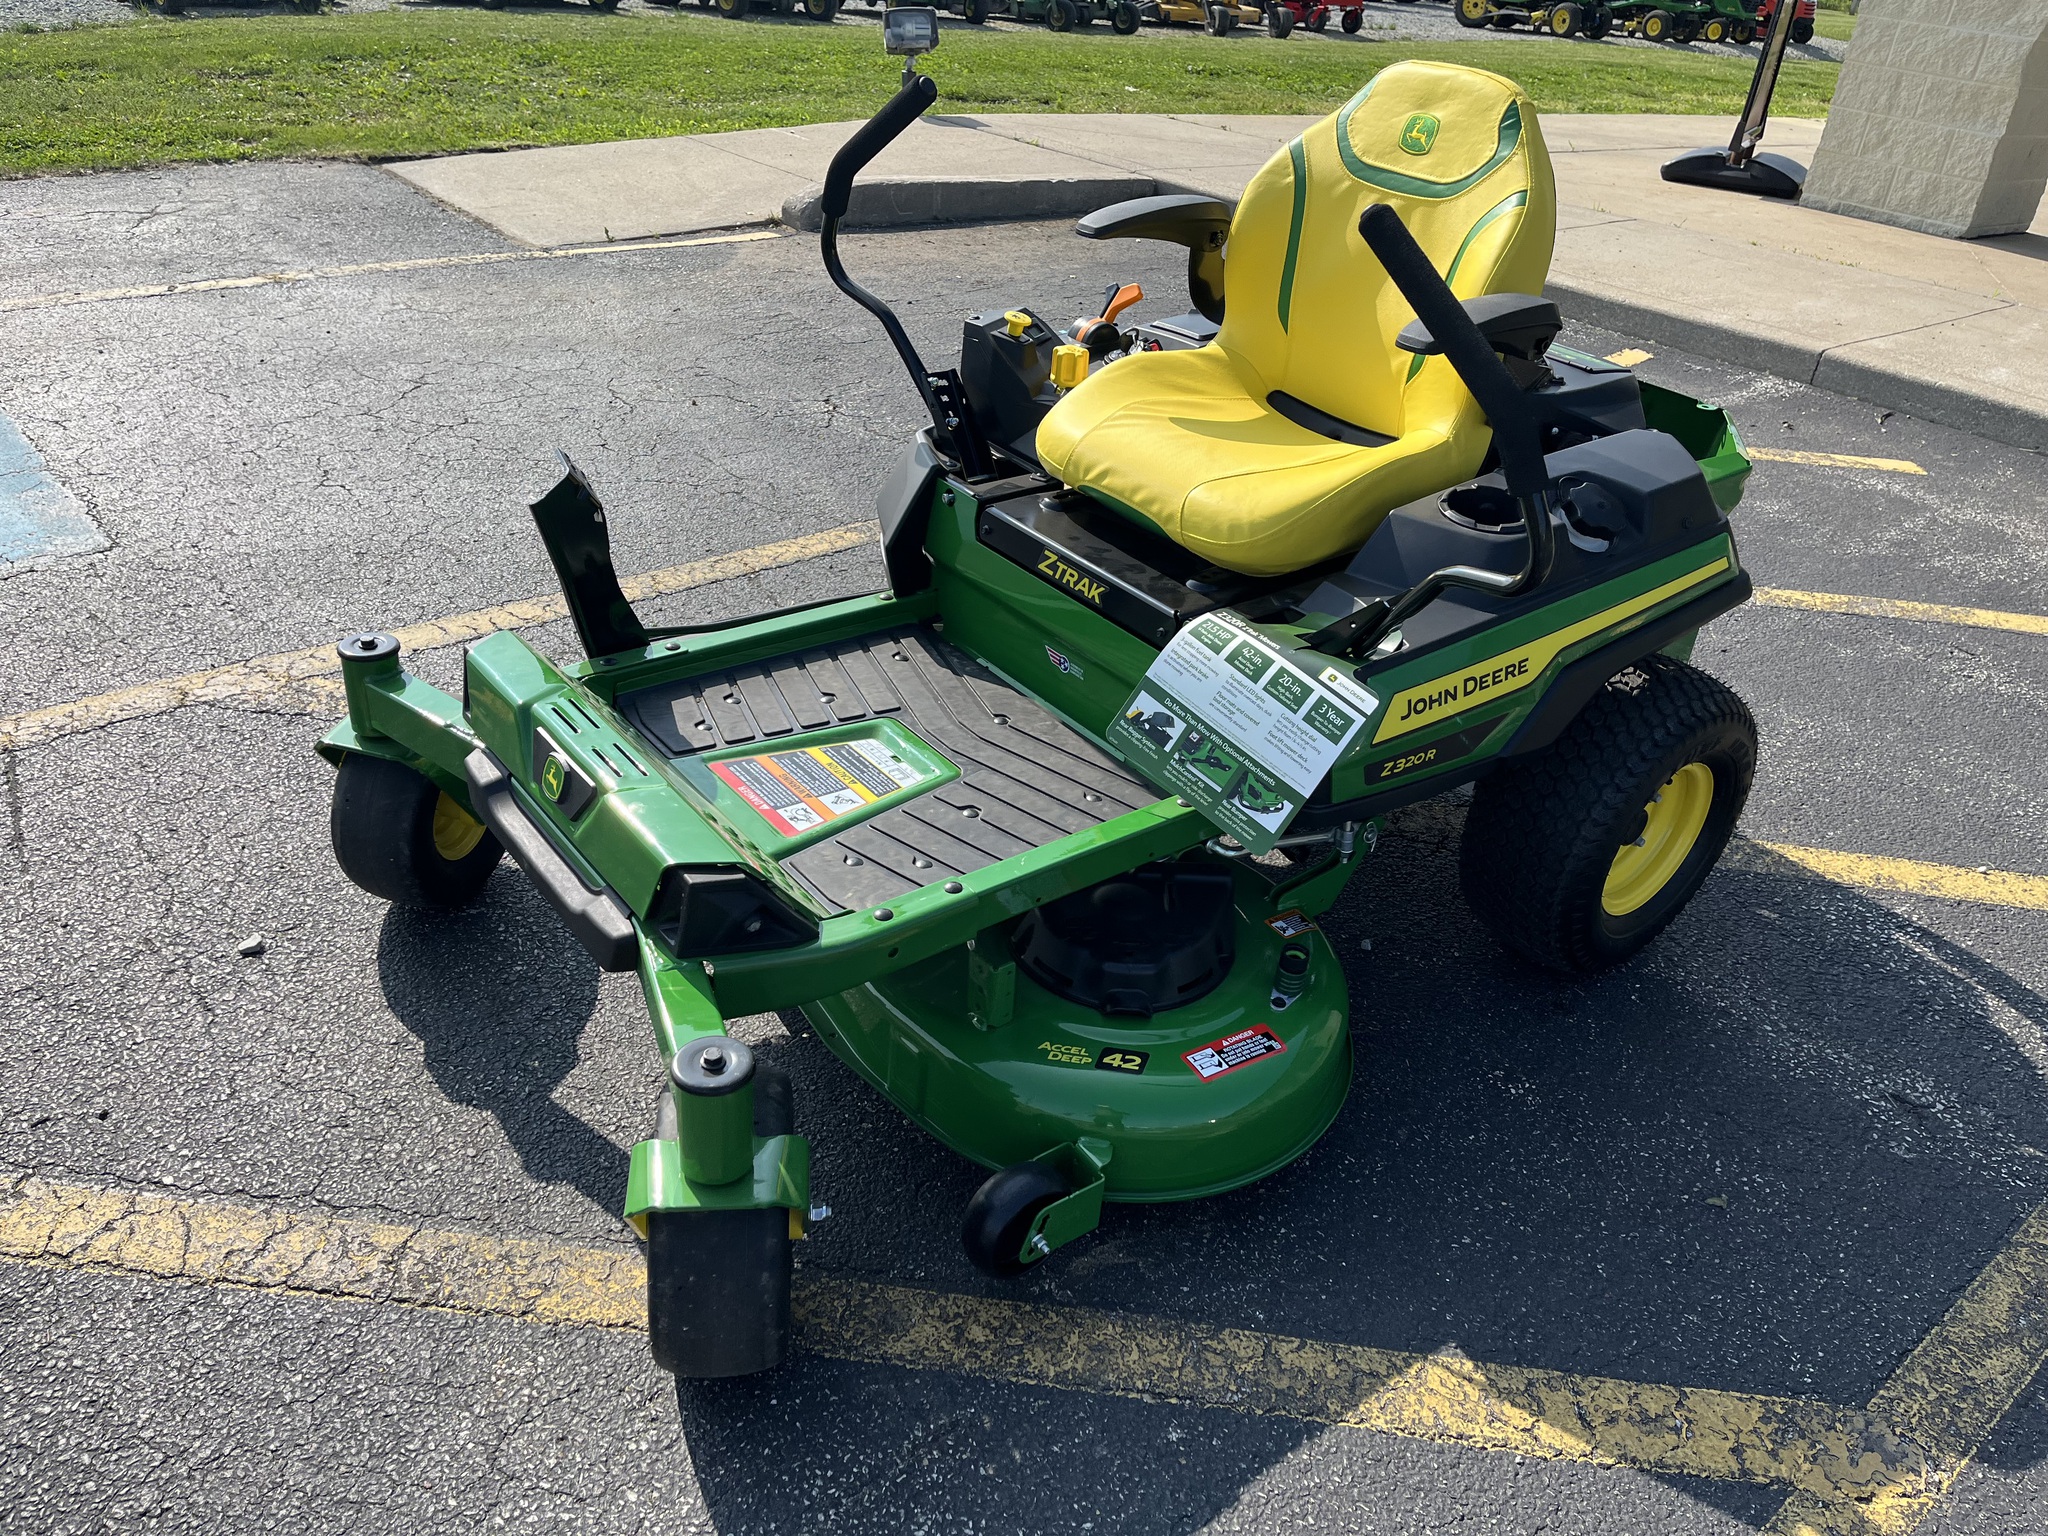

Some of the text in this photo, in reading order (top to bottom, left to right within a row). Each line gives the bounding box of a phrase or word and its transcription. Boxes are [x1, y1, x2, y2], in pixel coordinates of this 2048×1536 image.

[1037, 549, 1106, 604] ZTRAK
[1202, 621, 1220, 633] 21.5
[1242, 646, 1263, 667] 42-in.
[1229, 674, 1266, 705] Standard LED lights
[1279, 674, 1302, 696] 20-in.
[1337, 682, 1366, 703] JOHN DEERE
[1401, 657, 1529, 721] JOHN DEERE
[1216, 691, 1227, 701] Floor
[1236, 707, 1245, 715] and
[1220, 703, 1236, 716] storage
[1280, 713, 1296, 728] Cutting
[1295, 724, 1309, 737] height
[1319, 704, 1345, 727] 3 Year
[1120, 720, 1129, 729] Rear
[1141, 737, 1156, 750] System
[1164, 698, 1173, 707] Do
[1172, 704, 1186, 717] More
[1185, 713, 1198, 727] Than
[1197, 723, 1211, 736] Mow
[1210, 733, 1223, 746] With
[1222, 743, 1245, 763] Optional
[1243, 759, 1276, 786] Attachments
[1283, 743, 1298, 755] mower
[1297, 754, 1308, 763] deck
[1380, 749, 1437, 778] Z320R
[826, 762, 851, 780] CAUTION
[738, 786, 764, 805] DANGER
[1222, 800, 1248, 821] Rear Bumper
[1227, 1030, 1254, 1043] DANGER
[1037, 1041, 1089, 1056] ACCEL
[1047, 1051, 1093, 1065] DEEP
[1102, 1053, 1143, 1070] 42
